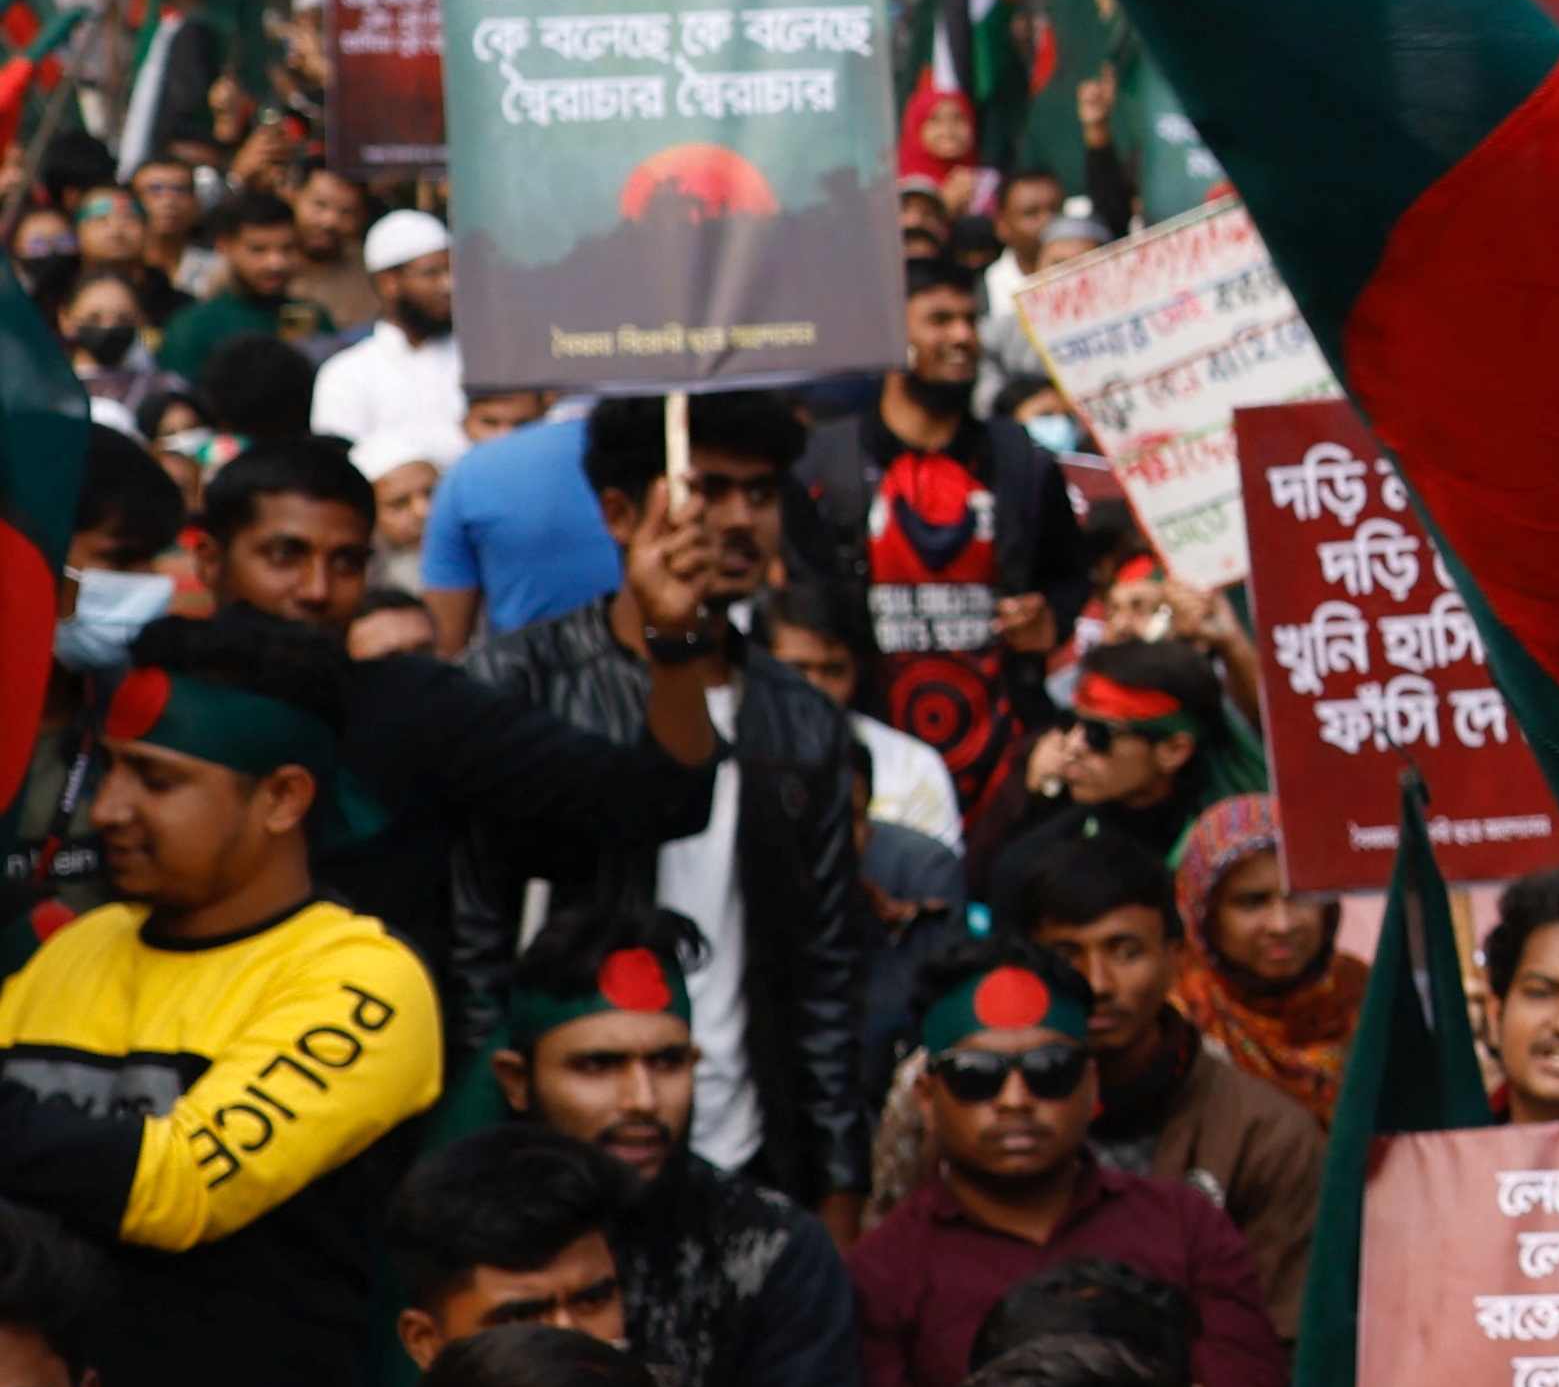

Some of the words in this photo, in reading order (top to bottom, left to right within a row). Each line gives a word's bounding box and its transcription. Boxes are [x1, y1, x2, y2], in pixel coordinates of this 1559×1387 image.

[473, 17, 530, 64] কে
[537, 13, 674, 64] বলেছে
[676, 9, 733, 56] কে
[742, 5, 874, 56] বলেছে
[500, 60, 666, 126] স্বৈরাচার
[672, 52, 838, 120] স্বৈরাচার
[1265, 441, 1368, 525] দড়ি
[1316, 517, 1421, 601] দড়ি
[1272, 600, 1371, 696] খুনি
[1314, 673, 1442, 754] ফাঁসি
[188, 980, 396, 1192] POLICE
